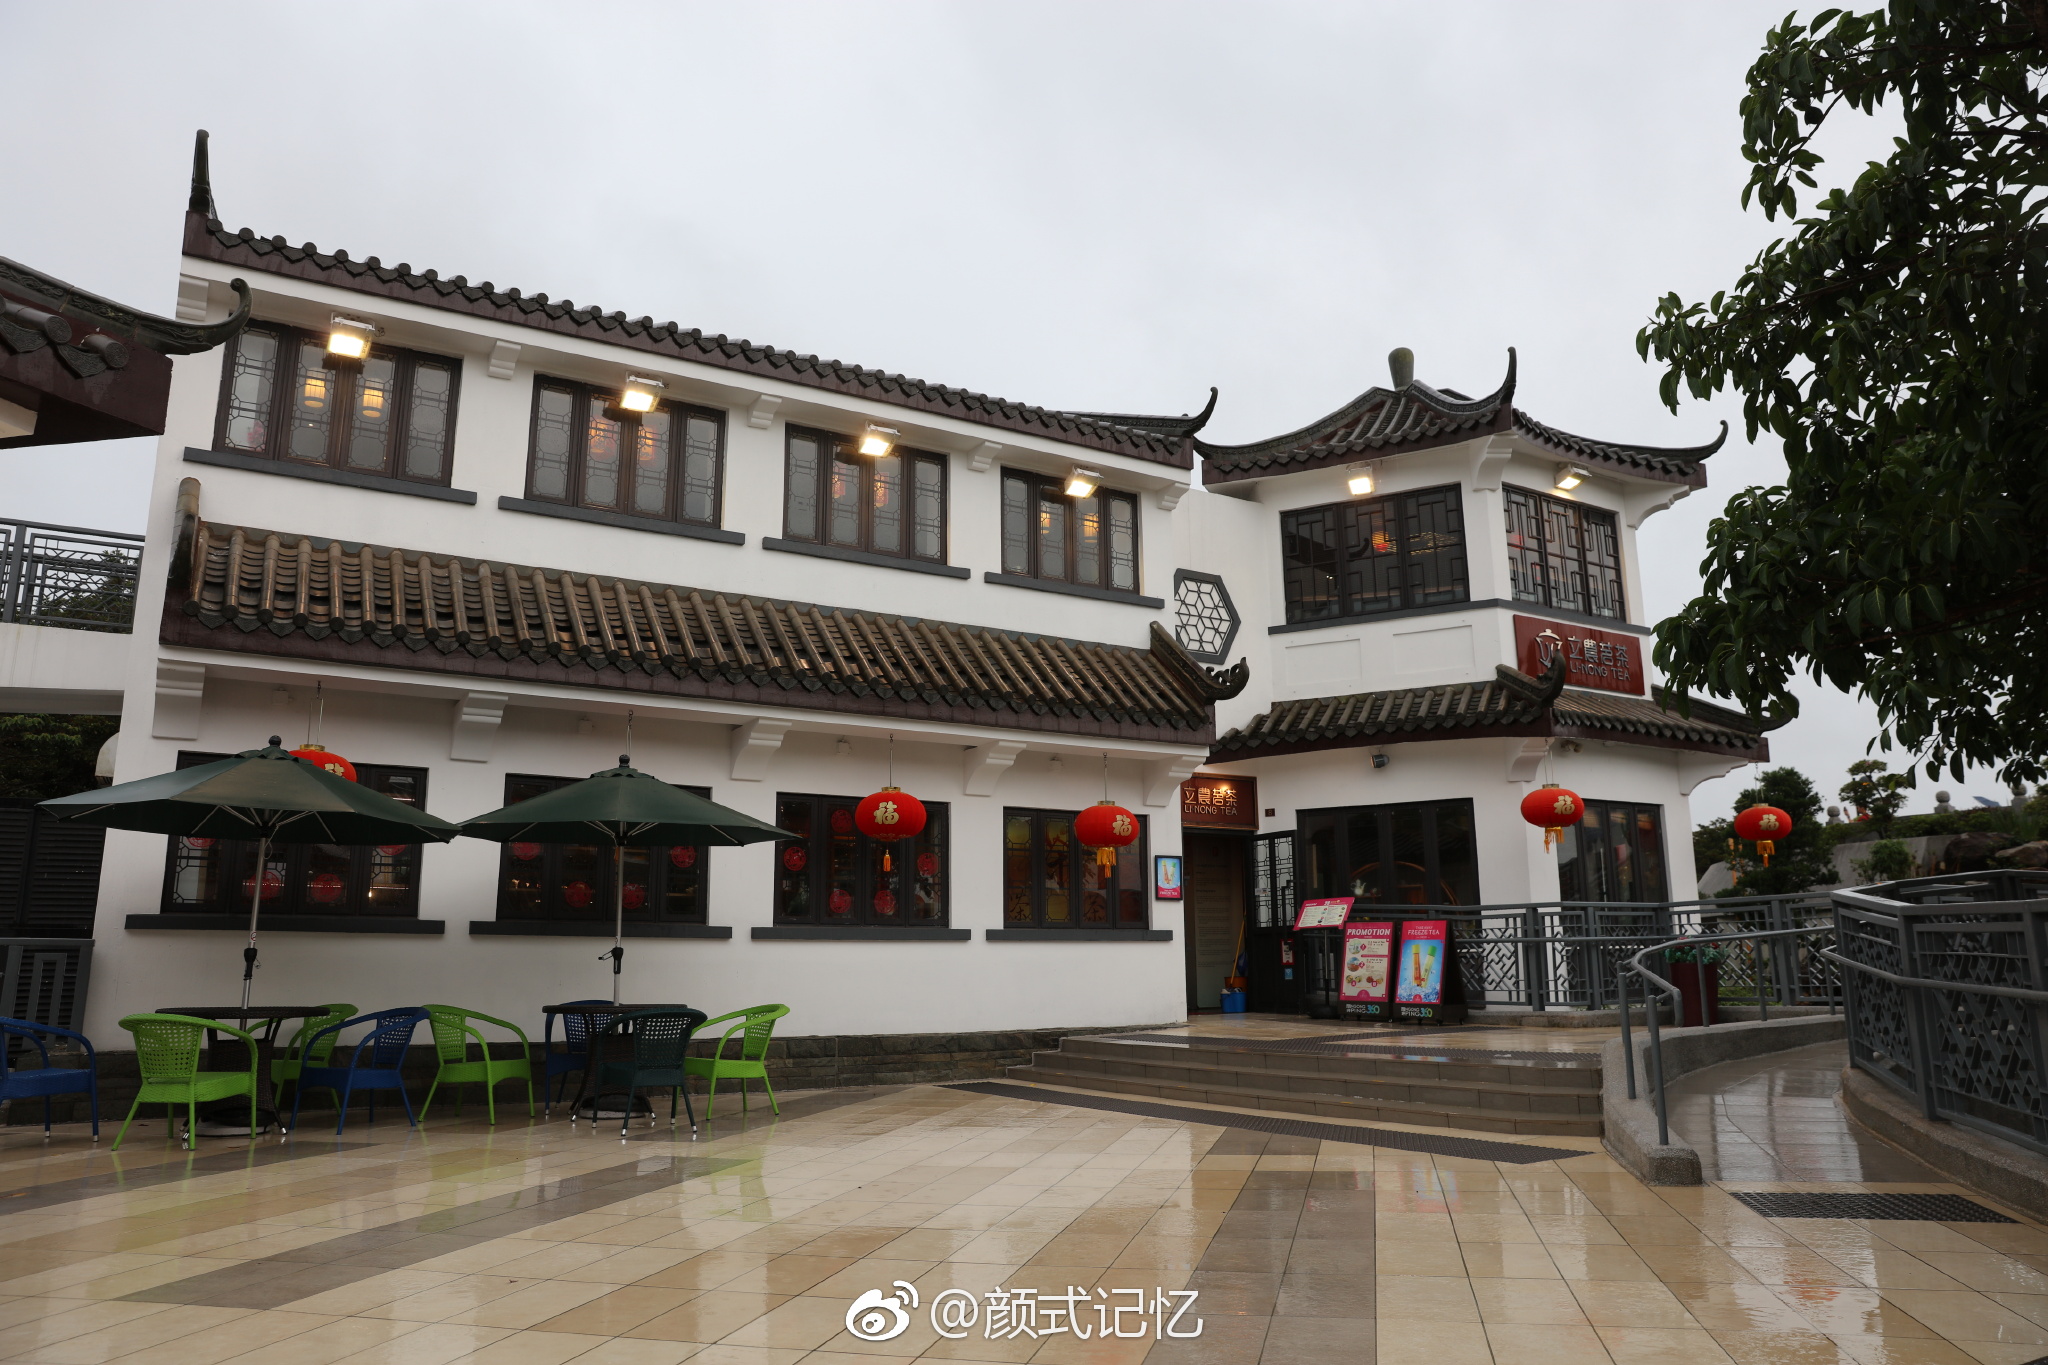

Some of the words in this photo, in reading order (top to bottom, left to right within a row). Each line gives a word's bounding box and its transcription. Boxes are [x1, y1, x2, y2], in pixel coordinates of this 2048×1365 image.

[1567, 635, 1629, 668] 立農茗茶
[1570, 660, 1608, 677] LI-NONG
[1610, 667, 1631, 681] TEA
[1183, 786, 1238, 806] 立農茗茶
[1553, 794, 1576, 815] 福
[873, 800, 900, 825] 福
[1220, 807, 1238, 816] TEA
[1112, 814, 1132, 837] 福
[1758, 813, 1780, 832] 福
[1347, 928, 1391, 936] PROMOTION
